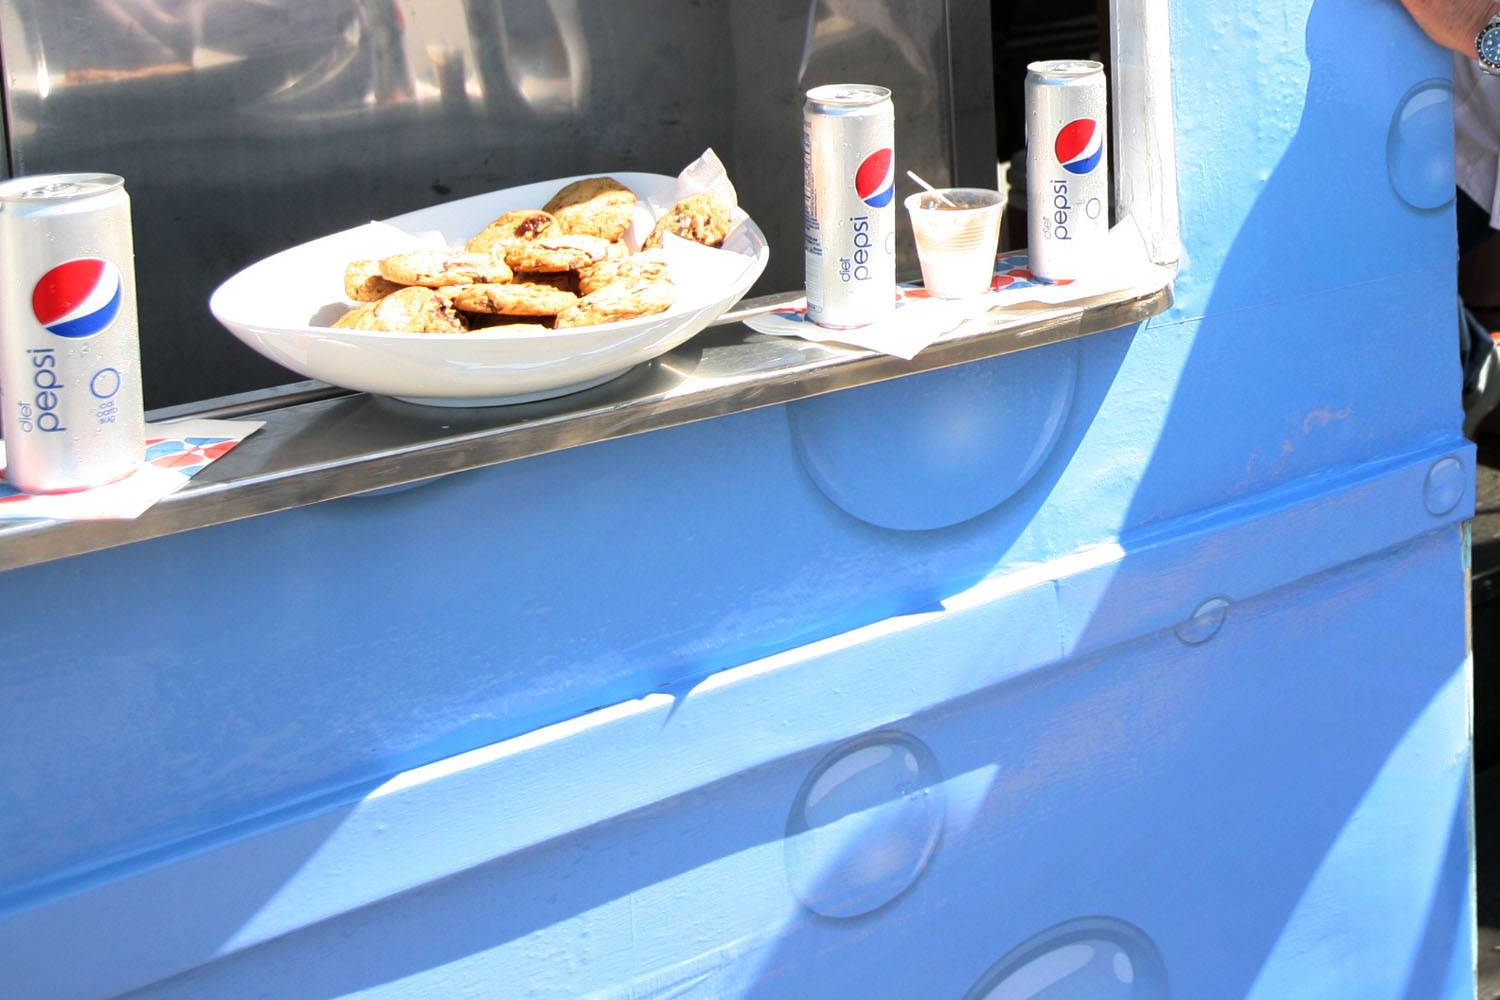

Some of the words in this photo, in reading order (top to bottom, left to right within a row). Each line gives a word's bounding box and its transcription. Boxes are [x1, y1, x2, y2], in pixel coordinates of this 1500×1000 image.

[1042, 216, 1052, 240] diet
[1050, 180, 1072, 240] pepsi
[840, 258, 851, 283] diet
[849, 216, 872, 281] pepsi
[26, 348, 67, 432] pepsi
[18, 400, 33, 433] diet
